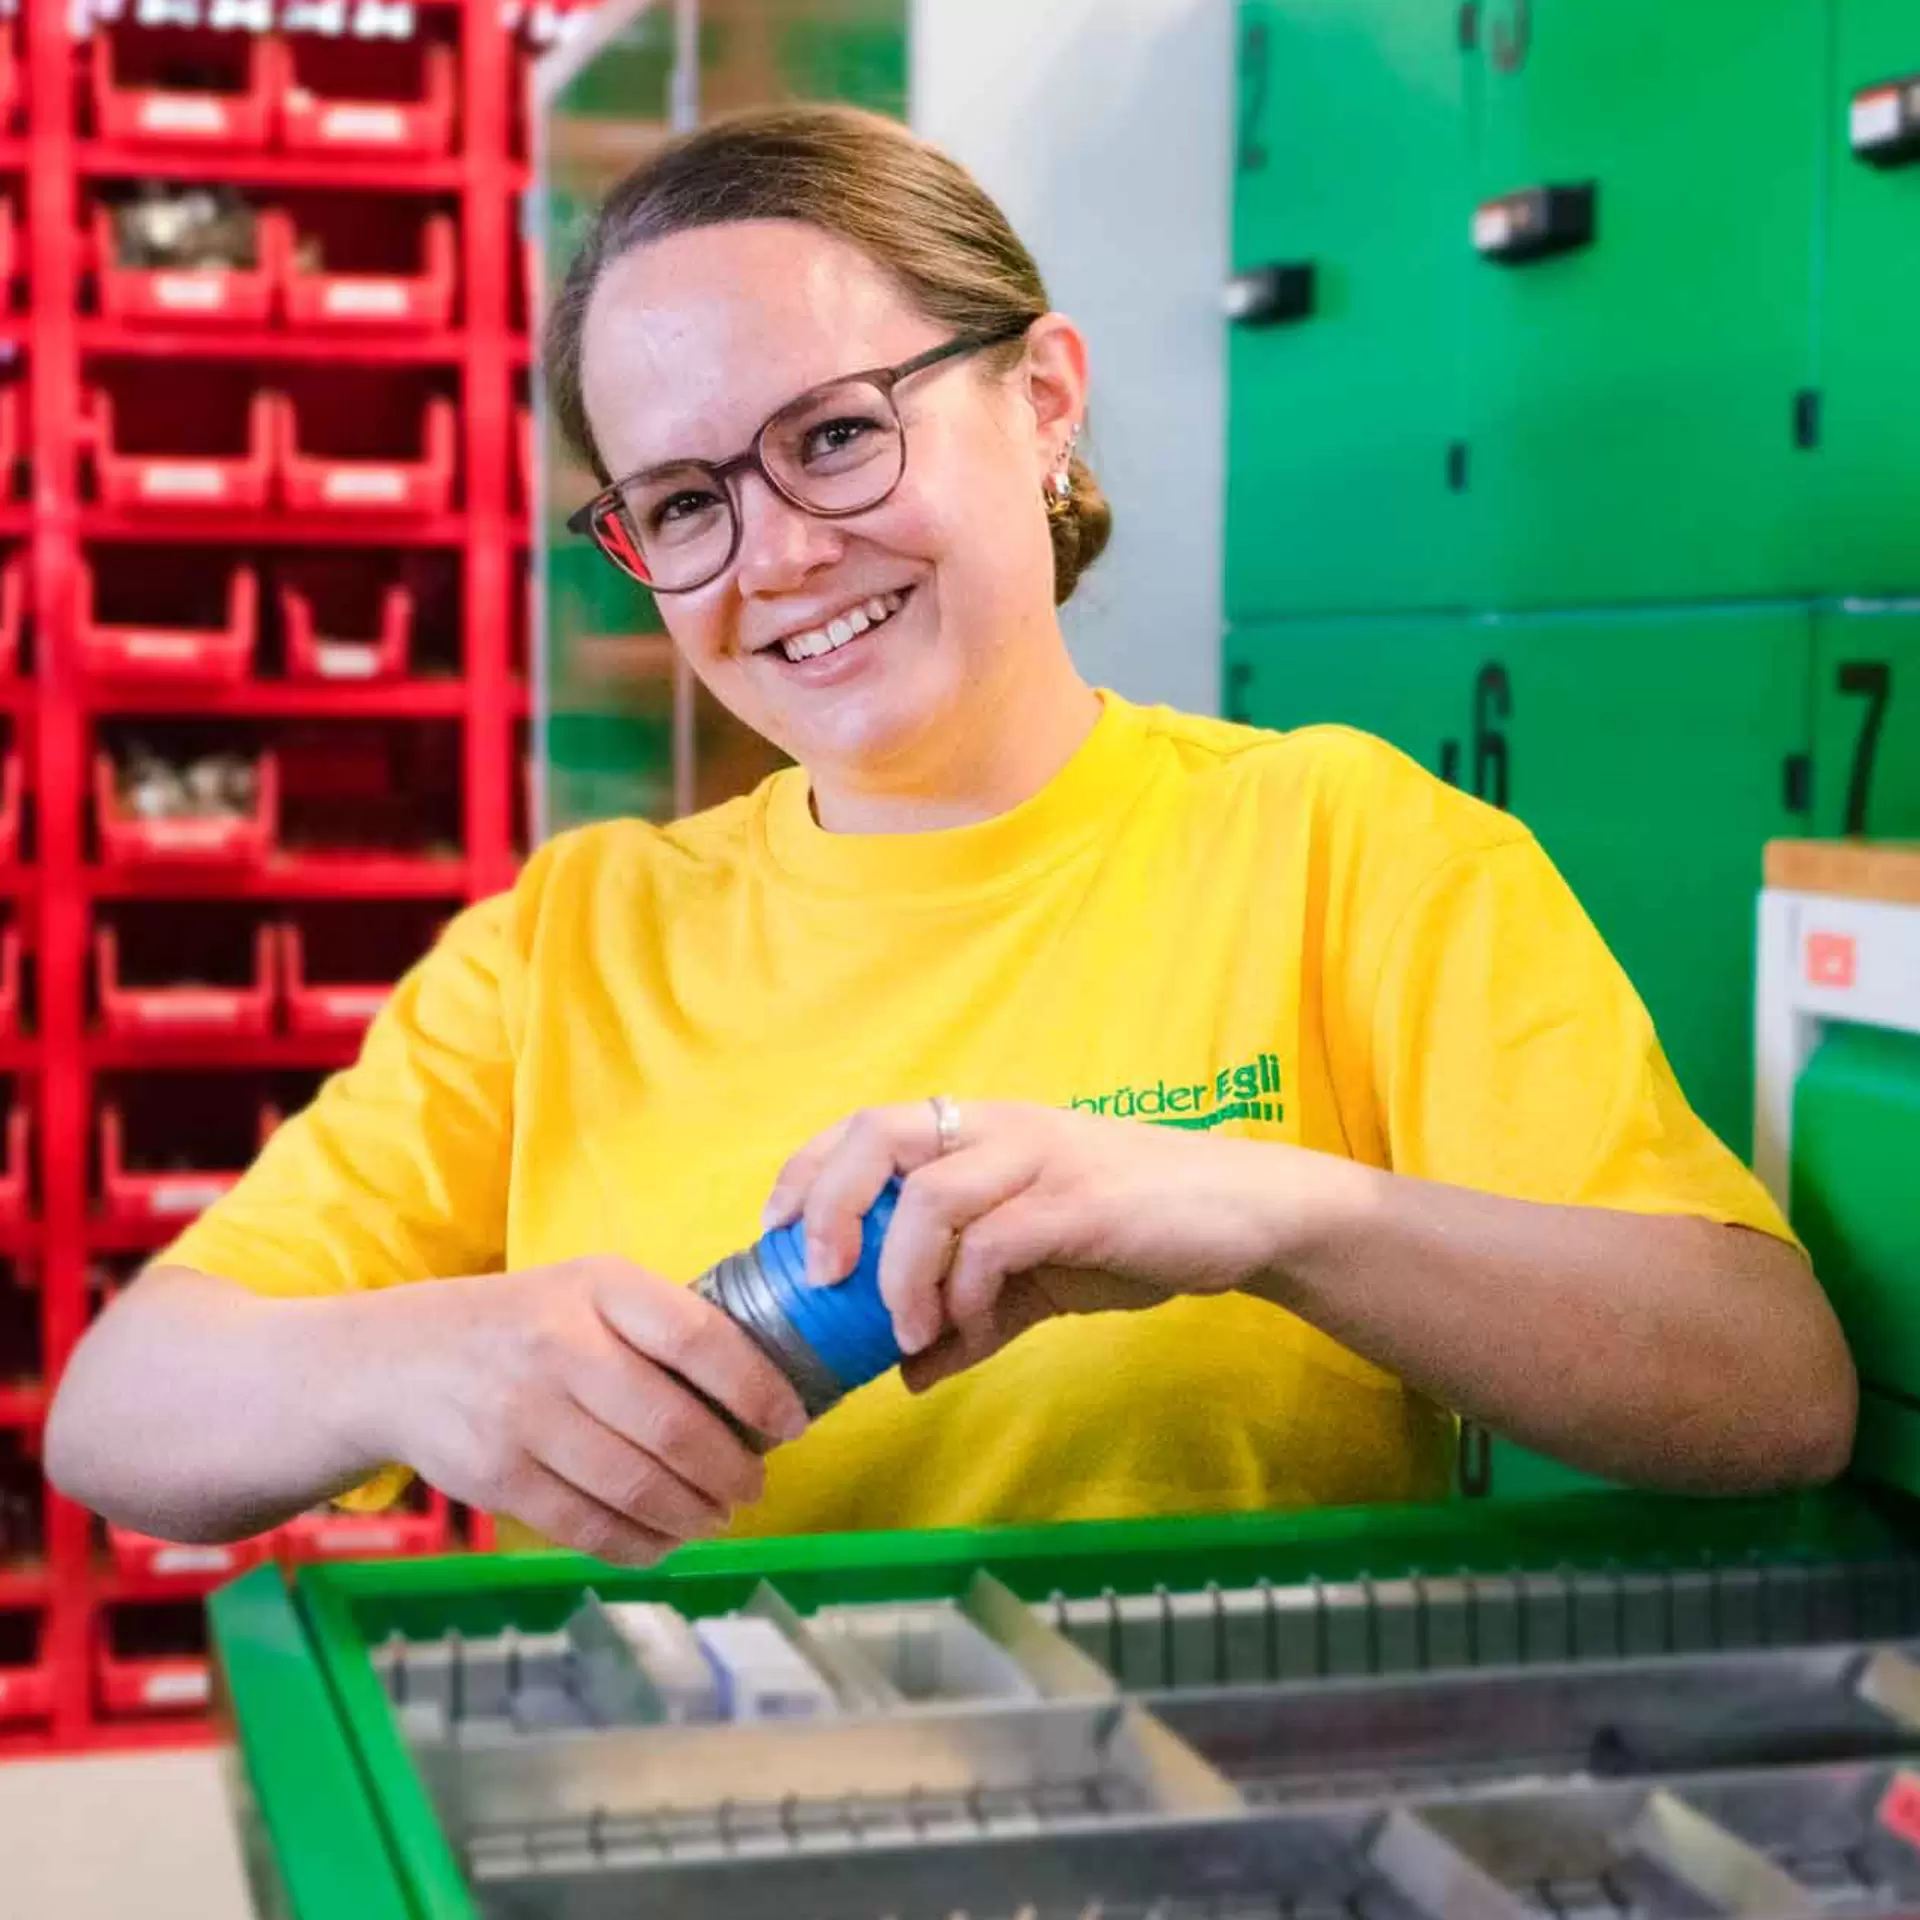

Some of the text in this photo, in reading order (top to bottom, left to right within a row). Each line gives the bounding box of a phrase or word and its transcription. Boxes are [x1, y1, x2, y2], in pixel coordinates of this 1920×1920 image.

[1474, 660, 1511, 811] 6
[1837, 660, 1891, 842] 7
[1215, 1052, 1282, 1102] Egli
